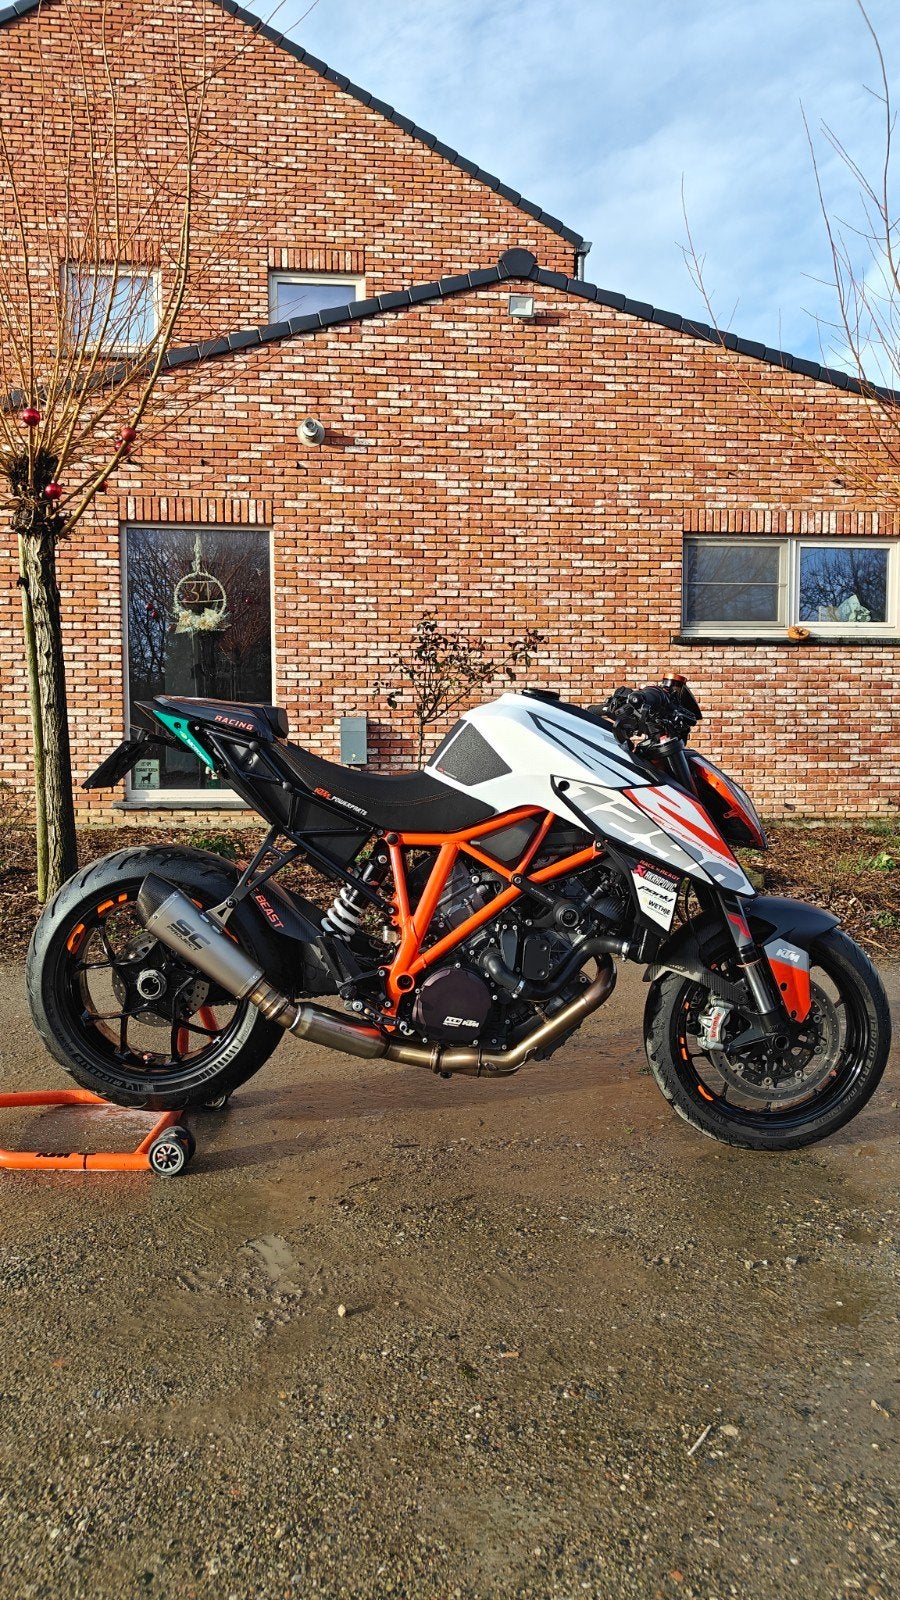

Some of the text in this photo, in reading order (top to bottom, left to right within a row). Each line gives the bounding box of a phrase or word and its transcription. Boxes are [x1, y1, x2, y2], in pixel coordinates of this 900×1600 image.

[214, 714, 254, 731] RACING
[332, 796, 368, 816] POWERPARTS
[639, 860, 655, 870] RACE
[255, 894, 284, 929] BEAST
[166, 925, 199, 951] PROJECT
[169, 919, 212, 950] SC
[775, 948, 801, 963] KTM
[710, 1012, 722, 1039] brembo
